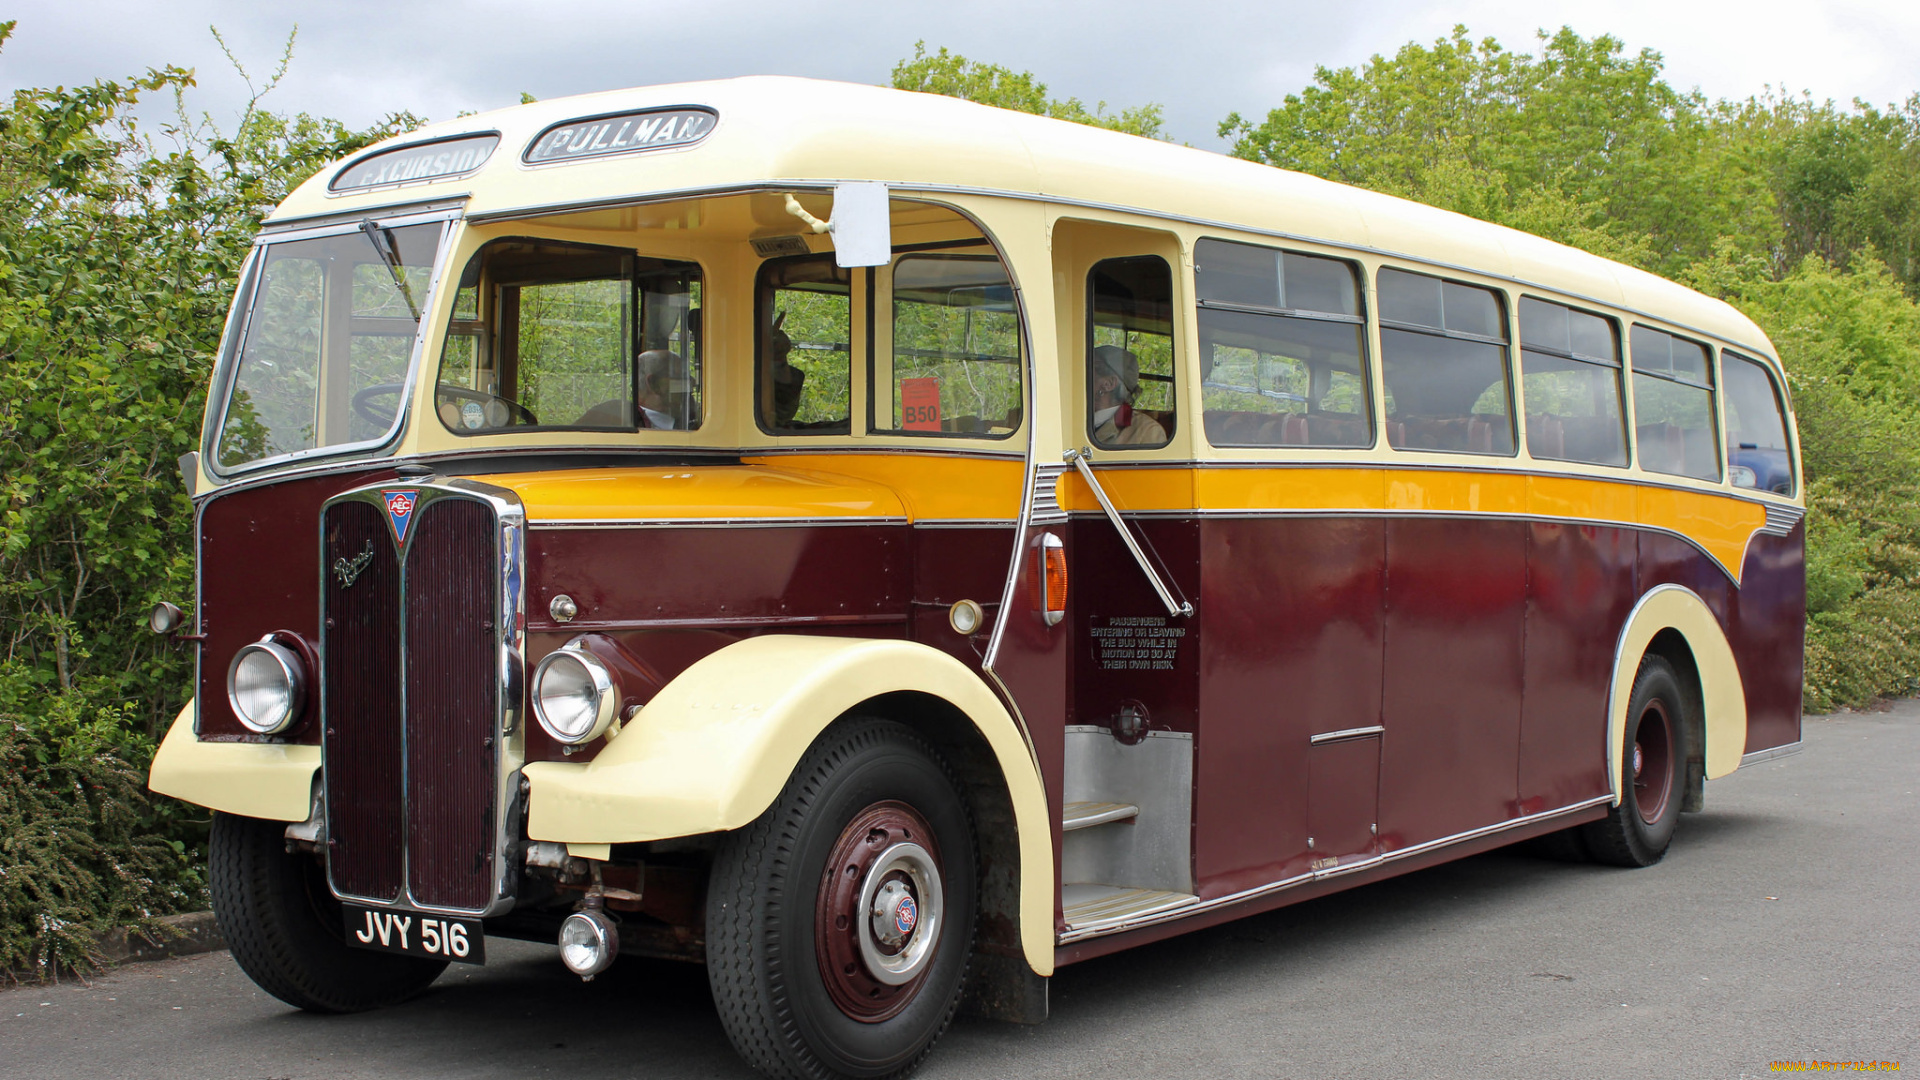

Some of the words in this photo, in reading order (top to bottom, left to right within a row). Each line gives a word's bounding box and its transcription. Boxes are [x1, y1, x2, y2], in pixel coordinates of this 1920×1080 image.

[544, 116, 704, 156] PULLMAN
[906, 406, 936, 423] B50
[390, 501, 410, 510] AEC
[1110, 617, 1165, 626] PASSENGERS
[1091, 628, 1132, 637] ENTERING
[1135, 628, 1147, 637] OR
[1149, 628, 1185, 637] LEAVING
[1100, 638, 1116, 648] THE
[1118, 638, 1135, 648] BUS
[1138, 638, 1165, 648] WHILE
[1168, 638, 1177, 648] IN
[1102, 650, 1134, 658] MOTION
[1136, 650, 1149, 658] DO
[1151, 650, 1163, 658] SO
[1164, 650, 1176, 658] AT
[1102, 660, 1127, 670] THEIR
[1129, 660, 1150, 670] OWN
[1152, 660, 1174, 670] RISK
[356, 911, 411, 949] JVY
[422, 918, 470, 957] 516
